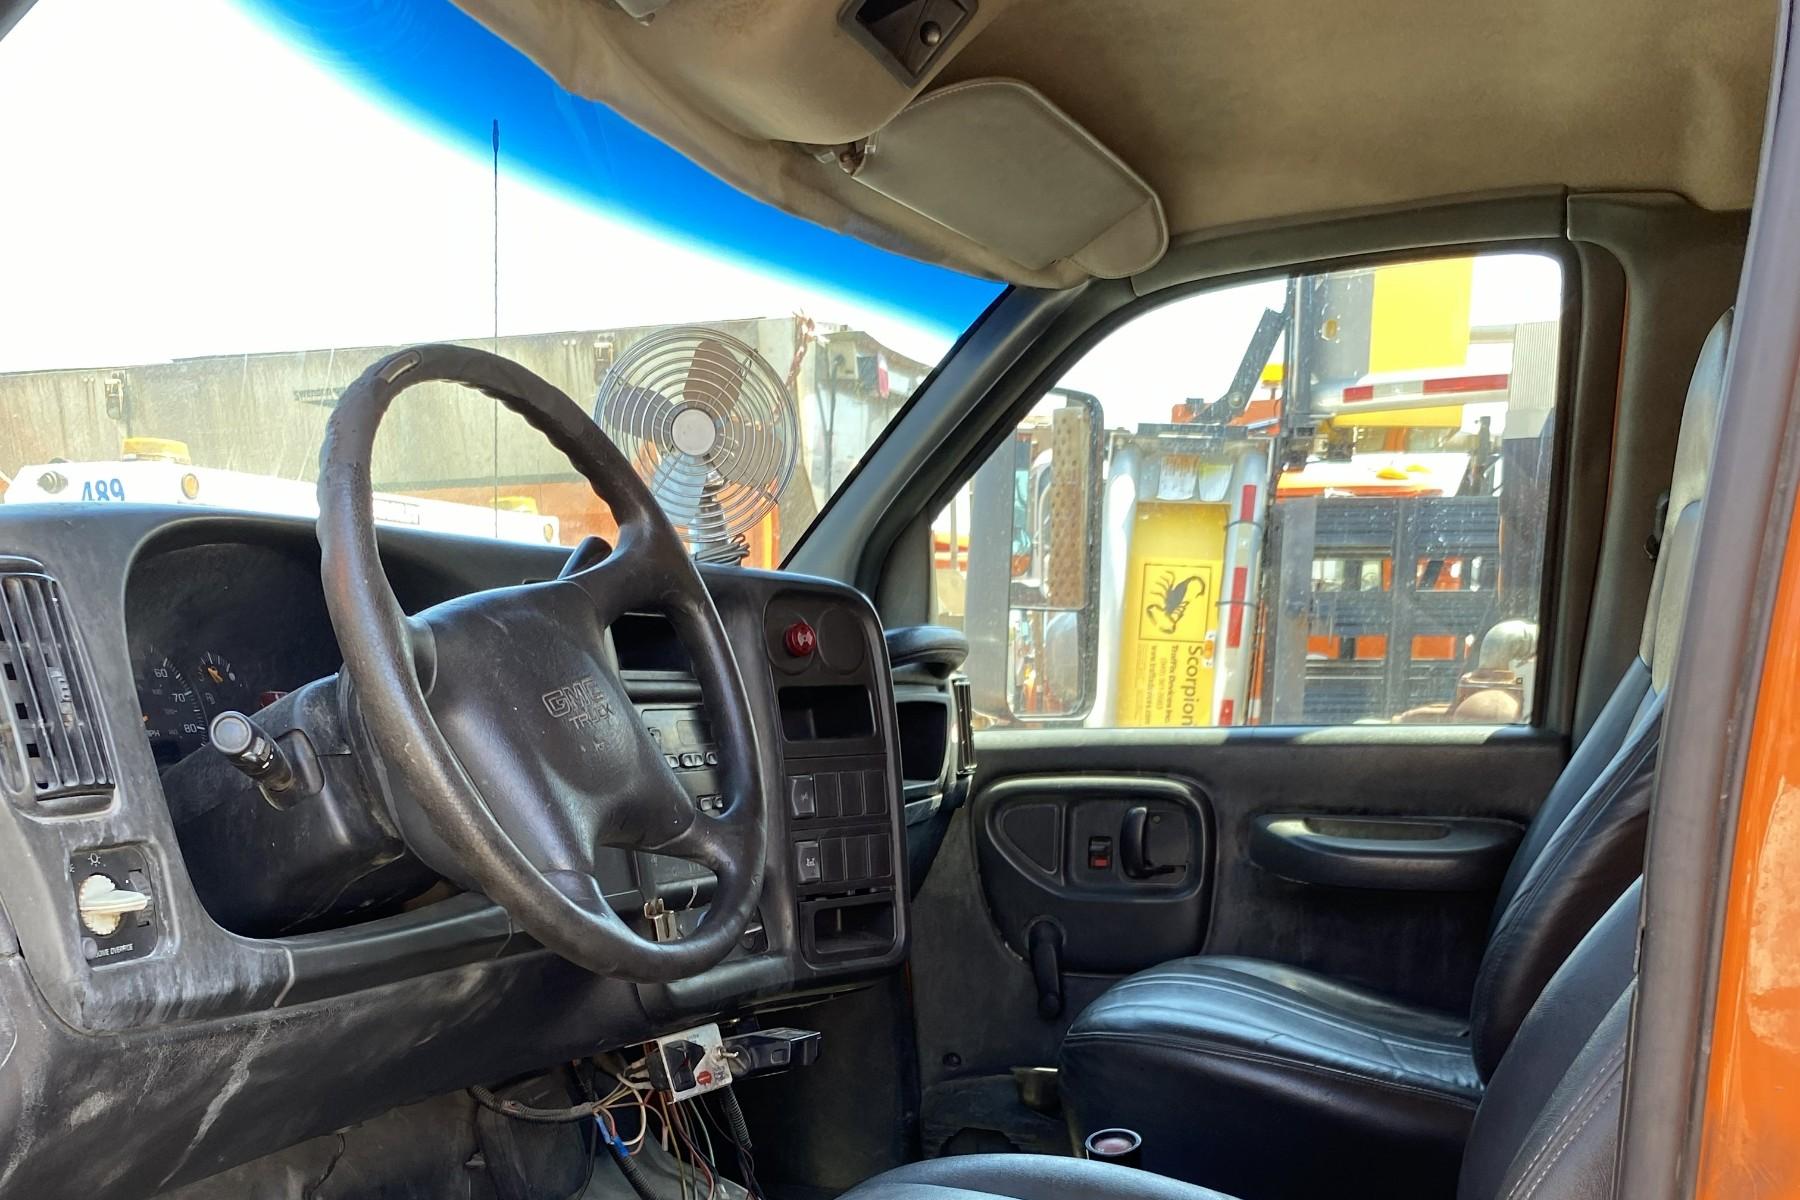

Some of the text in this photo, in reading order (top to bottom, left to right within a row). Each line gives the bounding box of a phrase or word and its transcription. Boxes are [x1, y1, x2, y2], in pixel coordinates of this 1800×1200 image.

[153, 668, 168, 678] 60
[1180, 645, 1204, 726] Scorpion
[171, 693, 186, 703] 70
[183, 723, 197, 733] 80
